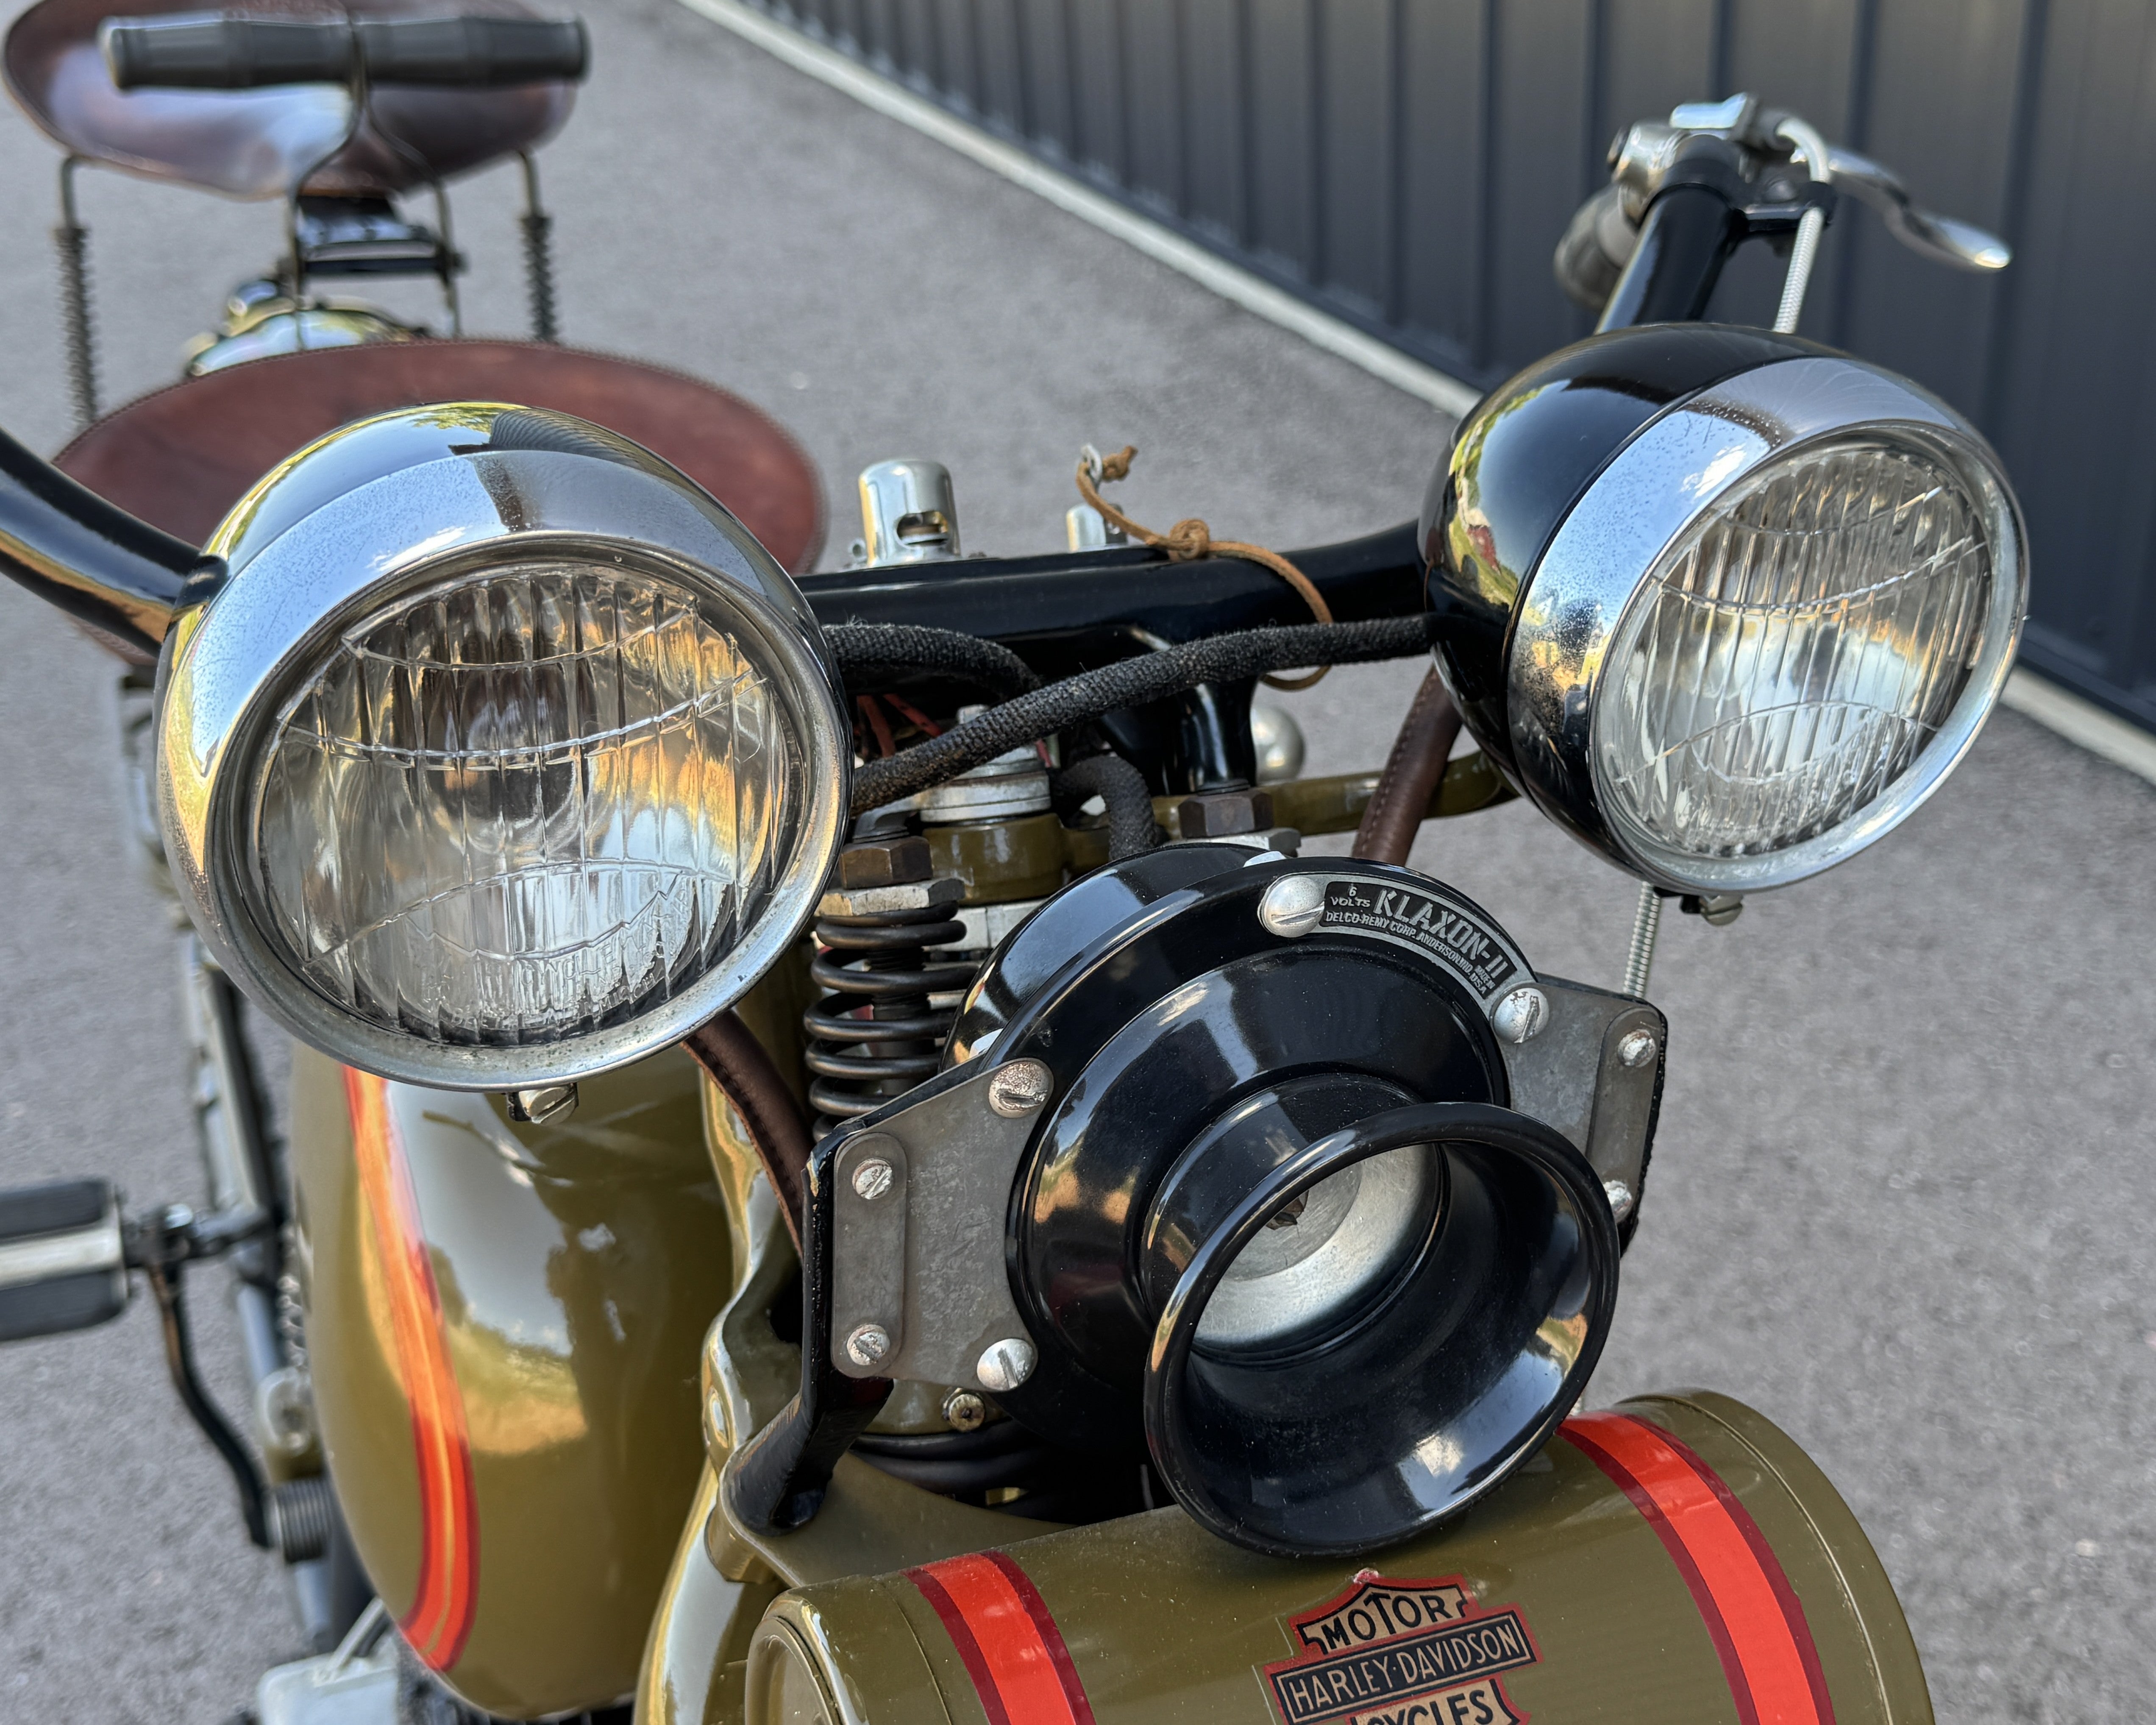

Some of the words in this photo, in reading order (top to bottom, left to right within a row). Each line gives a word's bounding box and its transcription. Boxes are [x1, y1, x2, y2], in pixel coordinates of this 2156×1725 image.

[1330, 897, 1371, 907] VOLTS
[1348, 883, 1357, 897] 6
[1325, 911, 1390, 928] DELCO-REMY
[1390, 920, 1416, 938] CORP.
[1321, 1591, 1453, 1650] MOTOR
[1367, 1690, 1494, 1725] YCLES
